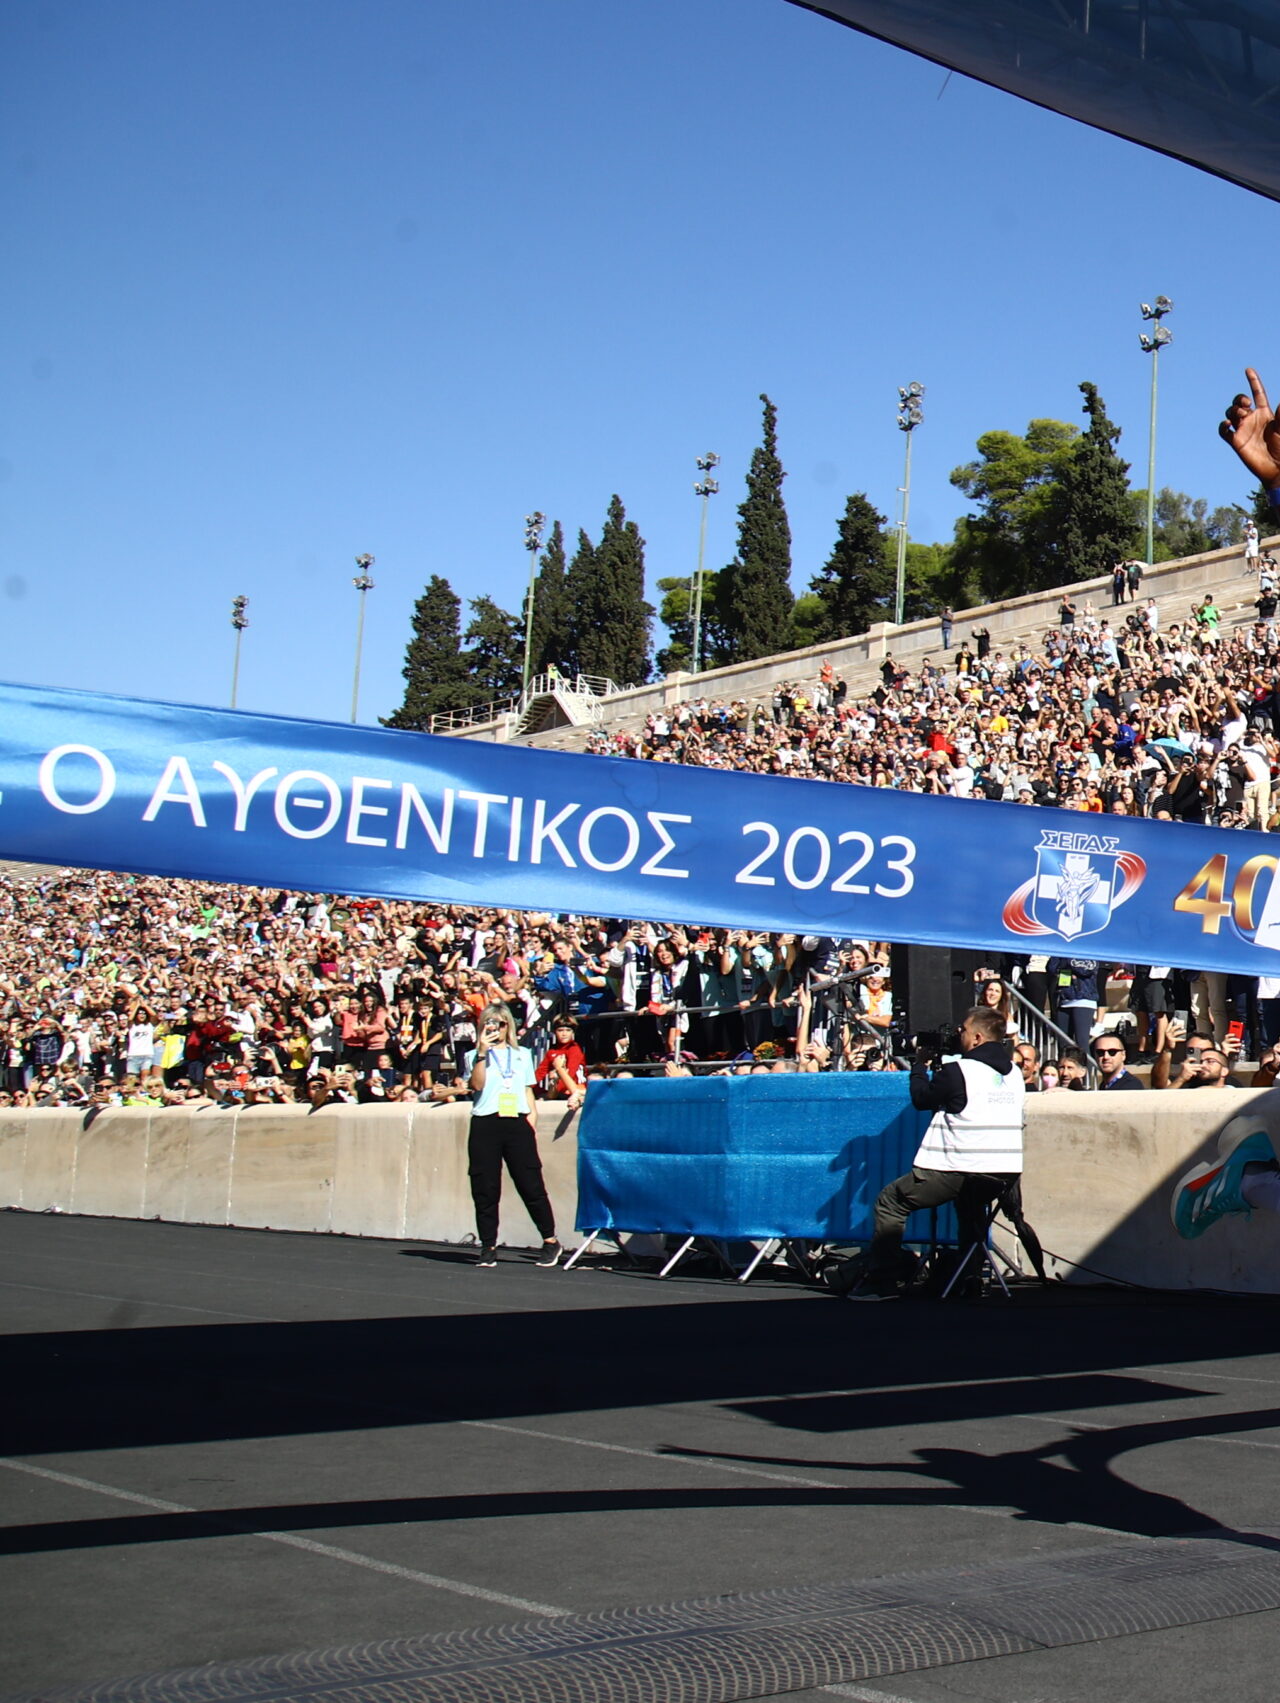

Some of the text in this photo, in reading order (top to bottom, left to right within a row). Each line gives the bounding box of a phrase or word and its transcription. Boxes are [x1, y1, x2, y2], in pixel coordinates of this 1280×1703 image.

[38, 743, 917, 898] Ο ΑΥΘΕΝΤΙΚΟΣ 2023
[1040, 829, 1120, 854] ΣΕΓΑΣ
